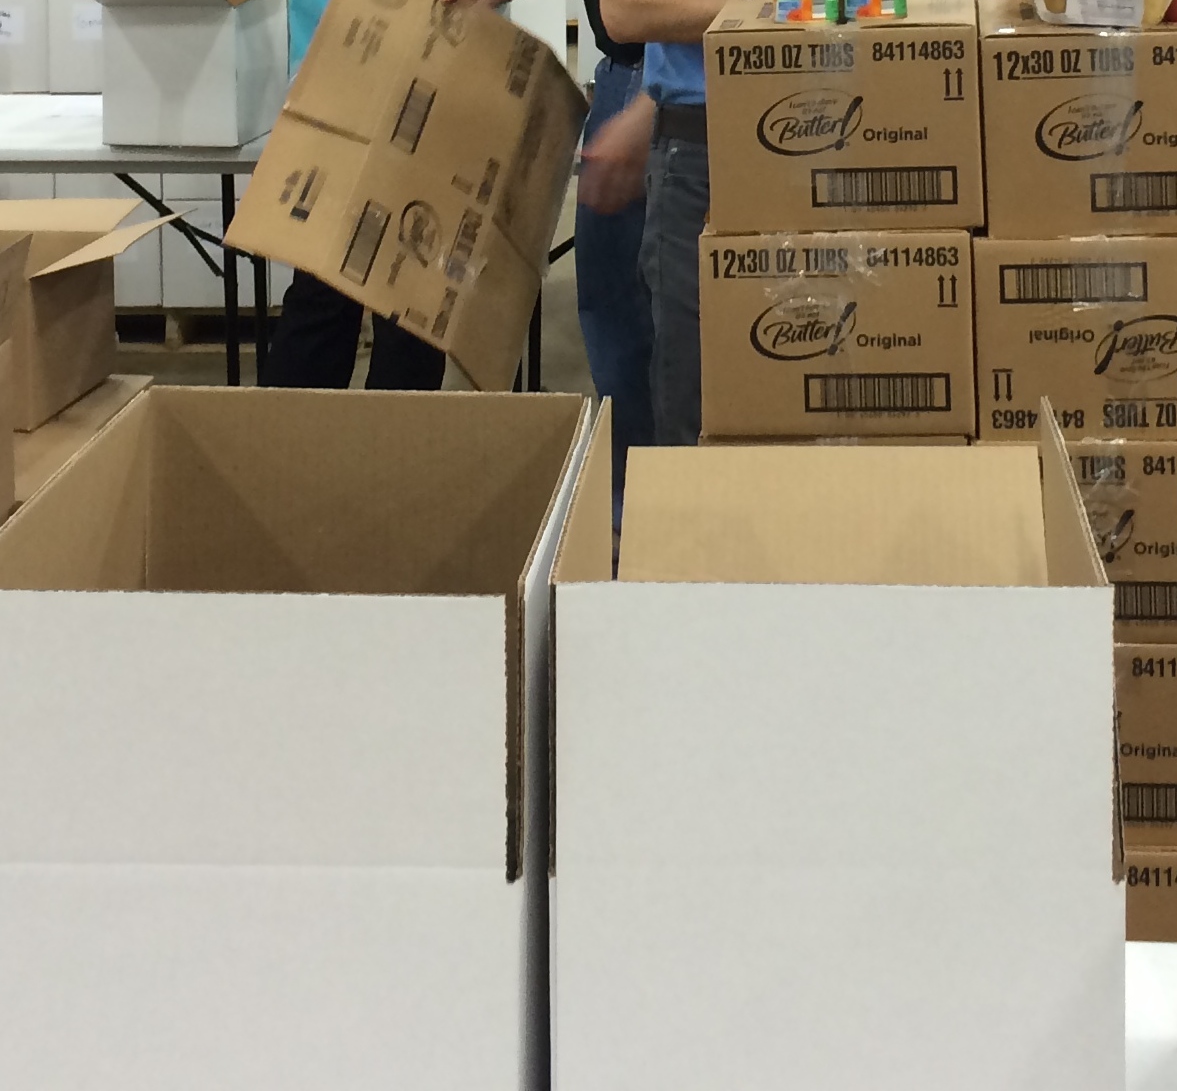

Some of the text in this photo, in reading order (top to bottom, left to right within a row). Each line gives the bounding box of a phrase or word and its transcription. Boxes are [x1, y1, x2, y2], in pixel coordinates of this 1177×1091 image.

[715, 43, 855, 75] 12x30 OZ TUBS
[872, 40, 965, 62] 84114863
[993, 46, 1135, 81] 12x30 OZ TUBS
[862, 126, 928, 144] Original
[709, 247, 849, 279] 12x30 OZ TUBS
[866, 246, 960, 268] 84114863
[856, 333, 922, 350] Original
[1028, 326, 1095, 344] Original
[991, 409, 1085, 430] 844863
[1102, 402, 1177, 428] OZ TUBS
